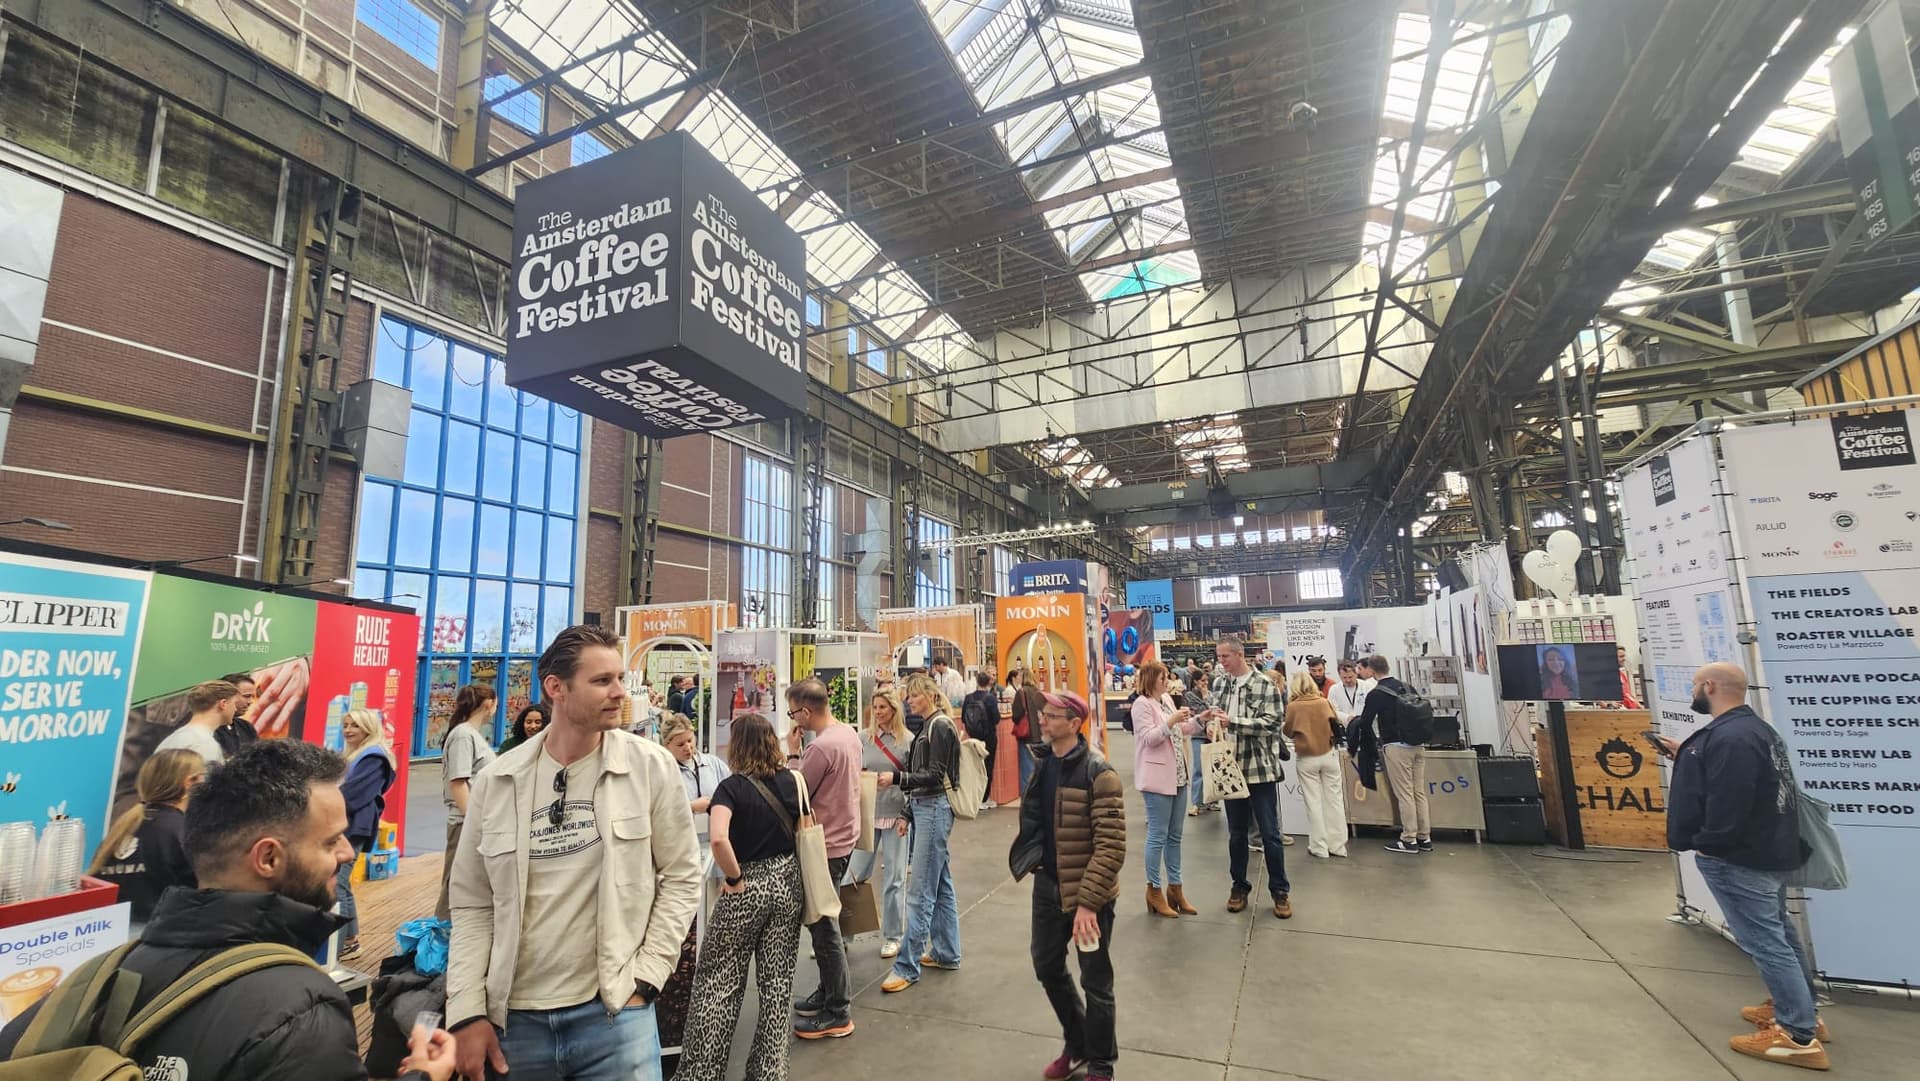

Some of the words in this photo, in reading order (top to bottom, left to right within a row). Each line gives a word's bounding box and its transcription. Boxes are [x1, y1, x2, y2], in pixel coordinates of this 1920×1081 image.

[1860, 179, 1878, 201] 167
[708, 194, 737, 230] The
[1863, 198, 1884, 221] 165
[520, 197, 672, 257] Amsterdam
[538, 209, 572, 232] The
[1867, 218, 1888, 240] 163
[692, 200, 802, 301] Amsterdam
[518, 232, 669, 300] Coffee
[691, 229, 801, 339] Coffee
[516, 269, 669, 339] Festival
[691, 271, 801, 373] Festival
[600, 368, 733, 428] Coffee
[626, 360, 766, 422] Festival
[569, 375, 703, 430] Amsterdam
[644, 415, 675, 429] The
[1839, 427, 1904, 438] Amsterdam
[1839, 434, 1906, 450] Coffee
[1841, 445, 1909, 459] Festival
[1762, 549, 1799, 558] MONIN
[1035, 573, 1070, 587] BRITA
[1768, 590, 1797, 599] THE
[1800, 587, 1851, 598] FIELDS
[1006, 602, 1070, 619] MONIN
[1646, 600, 1670, 610] FEATURES
[1771, 611, 1800, 620] THE
[1804, 607, 1884, 619] CREATORS
[1888, 606, 1919, 616] LAB
[212, 610, 272, 642] DRYK
[355, 615, 392, 646] RUDE
[643, 618, 687, 632] MONIN
[1776, 631, 1846, 641] ROASTER
[1849, 628, 1915, 638] VILLAGE
[1817, 642, 1827, 650] by
[1842, 641, 1884, 649] Marzocco
[353, 645, 389, 667] HEALTH
[56, 650, 121, 679] NOW,
[1784, 674, 1861, 684] 5THWAVE
[1, 681, 83, 711] SERVE
[1787, 696, 1816, 705] THE
[1821, 696, 1891, 705] CUPPING
[1662, 710, 1695, 723] EXHIBITORS
[1791, 718, 1821, 727] THE
[1825, 718, 1883, 727] COFFEE
[1797, 749, 1827, 758] THE
[1831, 750, 1876, 758] BREW
[1881, 750, 1912, 759] LAB
[1804, 780, 1870, 790] MAKERS
[1830, 803, 1863, 813] REET
[1868, 804, 1914, 814] FOOD
[562, 820, 595, 832] WORLDWIDE
[568, 840, 586, 850] REALITY
[0, 931, 69, 955] Double
[75, 920, 113, 937] Milk
[16, 938, 96, 965] Specials
[155, 1055, 177, 1068] THE
